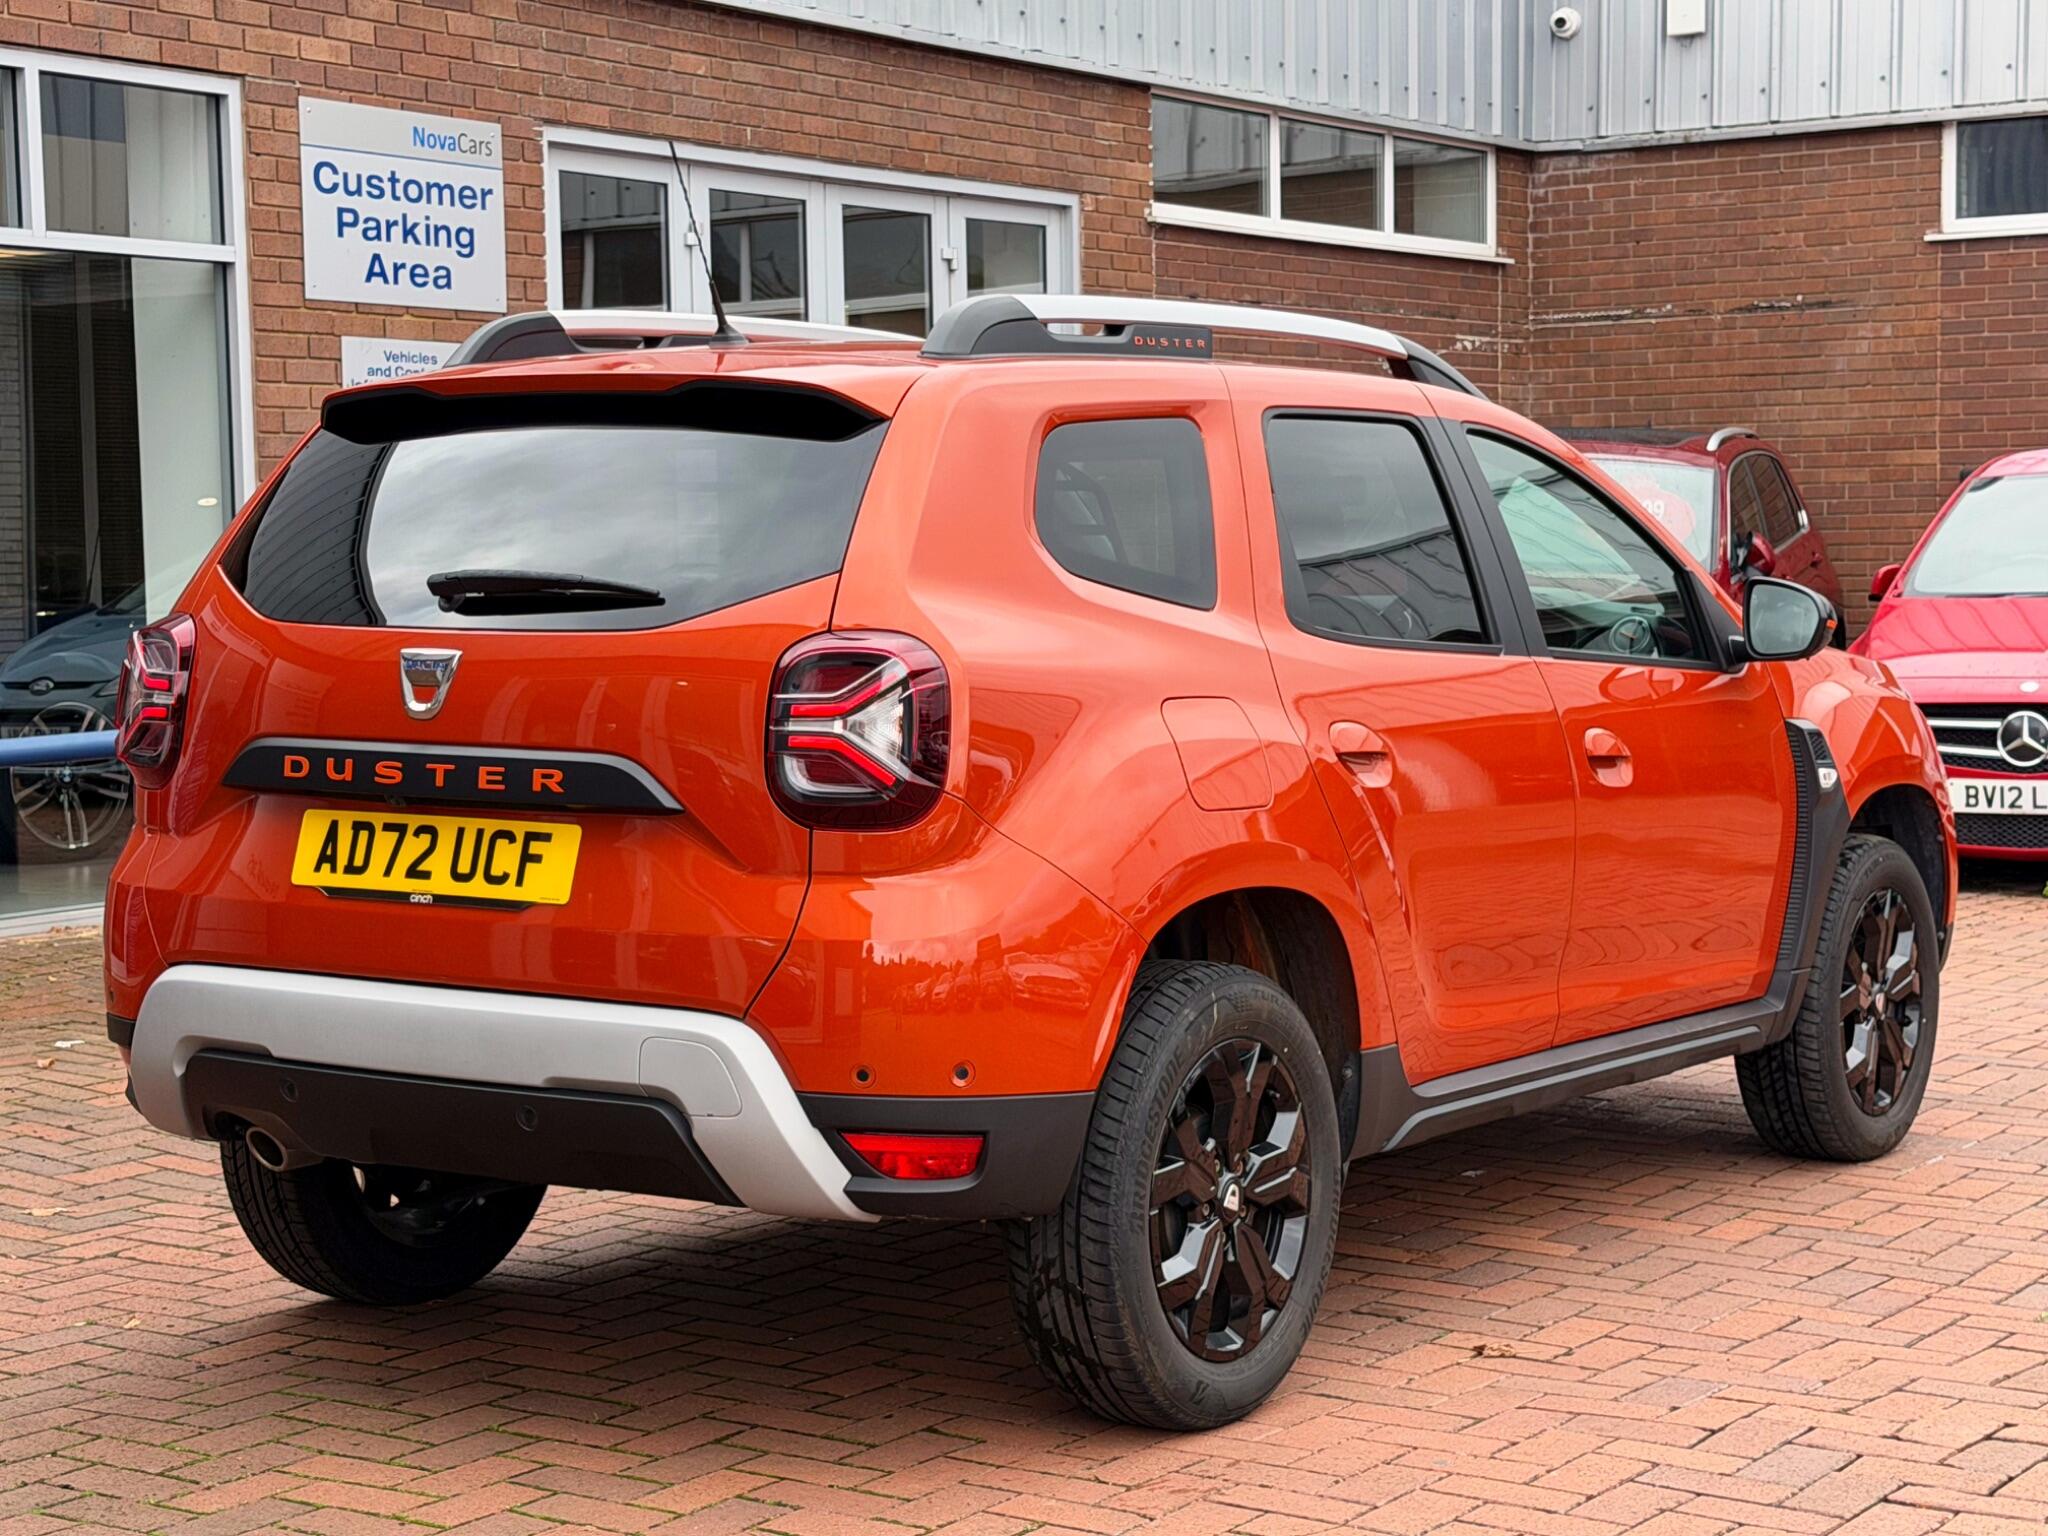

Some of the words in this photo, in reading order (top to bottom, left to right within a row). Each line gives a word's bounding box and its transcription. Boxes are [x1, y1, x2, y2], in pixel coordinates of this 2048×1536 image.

[412, 126, 493, 157] NovaCars
[313, 161, 493, 211] Customer
[336, 206, 475, 259] Parking
[364, 253, 452, 290] Area
[383, 350, 438, 366] Vehicles
[1134, 335, 1206, 349] DUSTER
[367, 365, 392, 378] and
[283, 755, 564, 793] DUSTER
[1964, 785, 2023, 809] BV12
[313, 819, 439, 881] AD72
[450, 826, 553, 887] UCF
